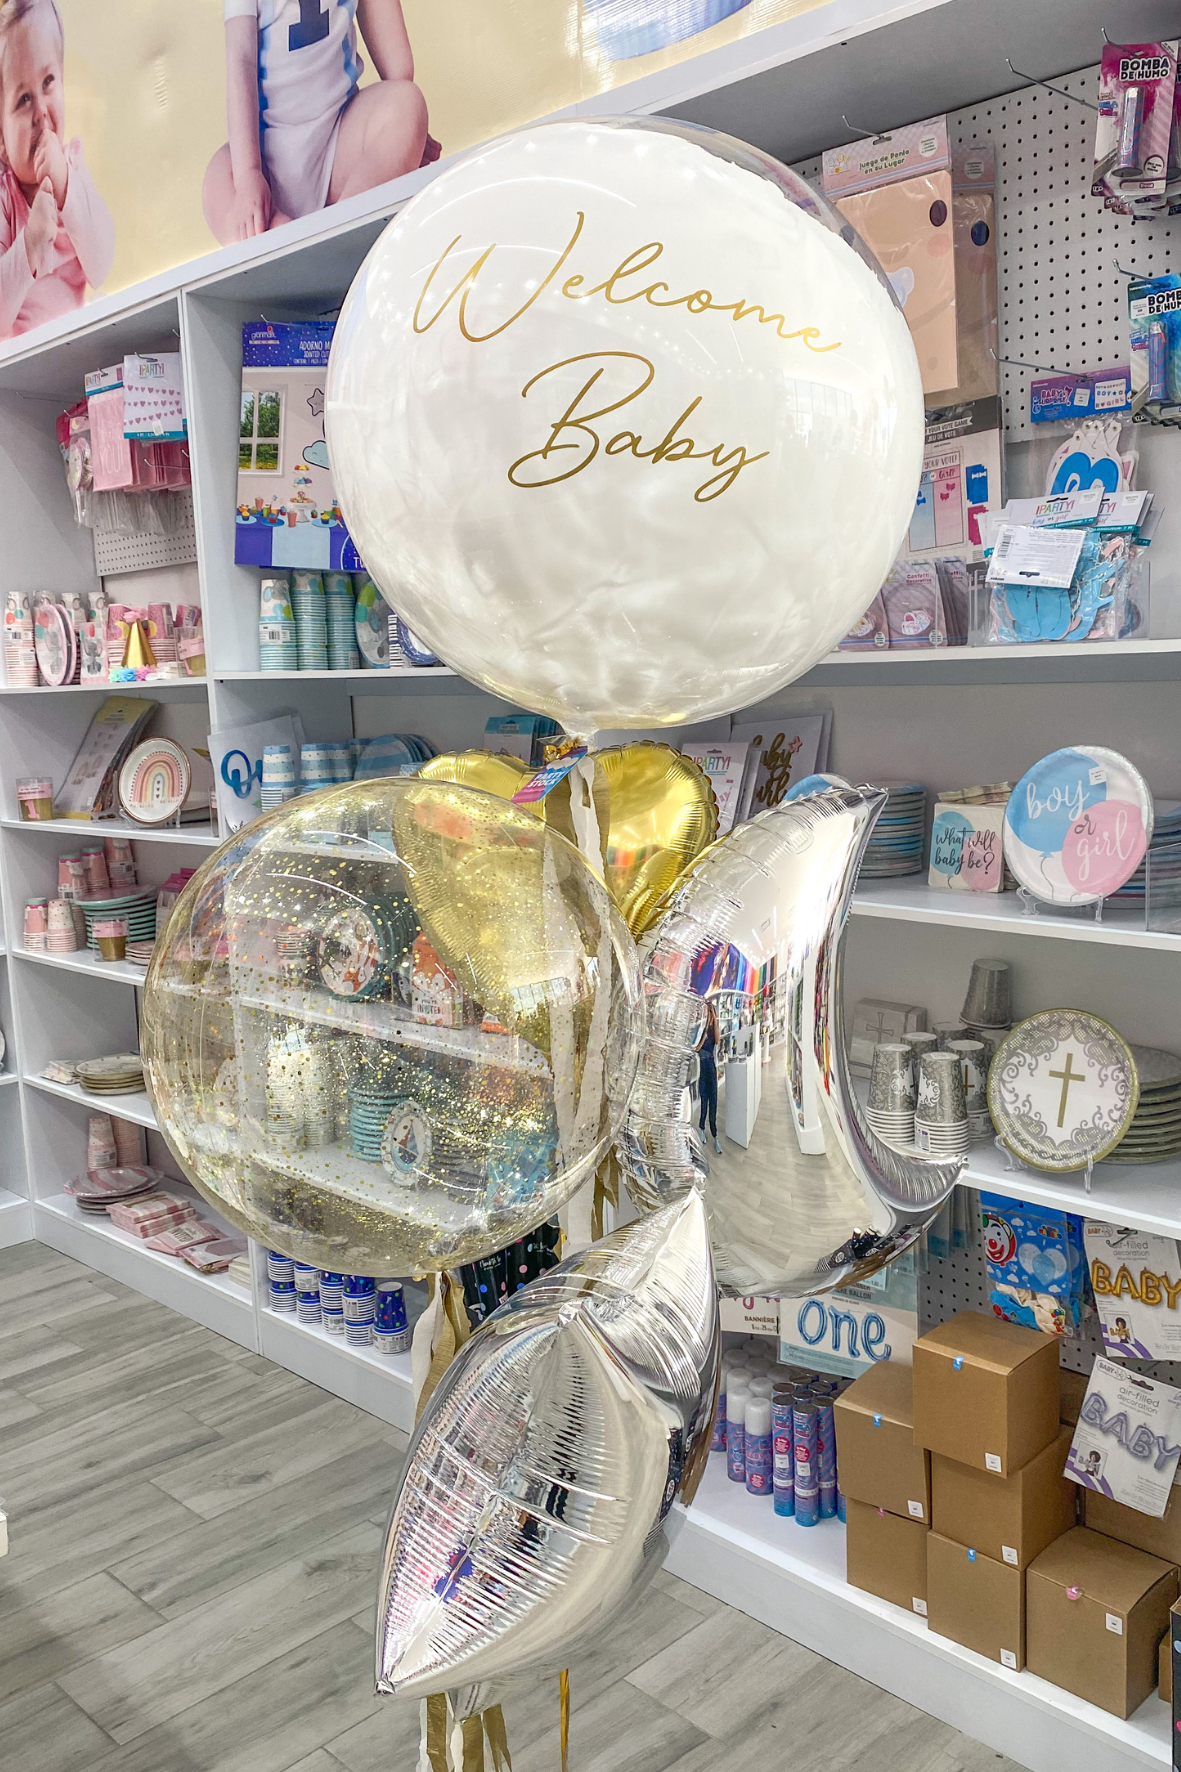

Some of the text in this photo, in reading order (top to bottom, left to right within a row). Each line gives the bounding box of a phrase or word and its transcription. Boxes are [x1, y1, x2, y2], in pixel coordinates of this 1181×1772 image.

[1121, 57, 1170, 71] BOMBA
[1120, 69, 1169, 80] DE HUMO
[859, 158, 879, 170] Juego
[880, 155, 889, 163] de
[864, 158, 905, 175] en su Lugar
[413, 211, 842, 353] Welcome
[1148, 290, 1181, 306] BOMB
[1148, 305, 1162, 315] DE
[299, 341, 323, 351] ADORNO
[508, 351, 770, 503] Baby
[928, 418, 969, 434] YOUR VOTE GAME
[928, 430, 957, 443] JEU DE VOTE
[527, 779, 557, 788] STOCK
[534, 770, 566, 781] PARTY
[1026, 780, 1090, 821] boy
[1074, 814, 1097, 836] or
[935, 827, 996, 852] what will
[1076, 810, 1136, 881] girl
[934, 848, 995, 875] baby be?
[1092, 1258, 1181, 1310] BABY
[848, 1289, 872, 1300] BALLON
[744, 1315, 776, 1323] BANNIÈRE
[1117, 1393, 1158, 1414] decoration
[1119, 1386, 1161, 1408] air-filled
[1080, 1389, 1181, 1471] BABY
